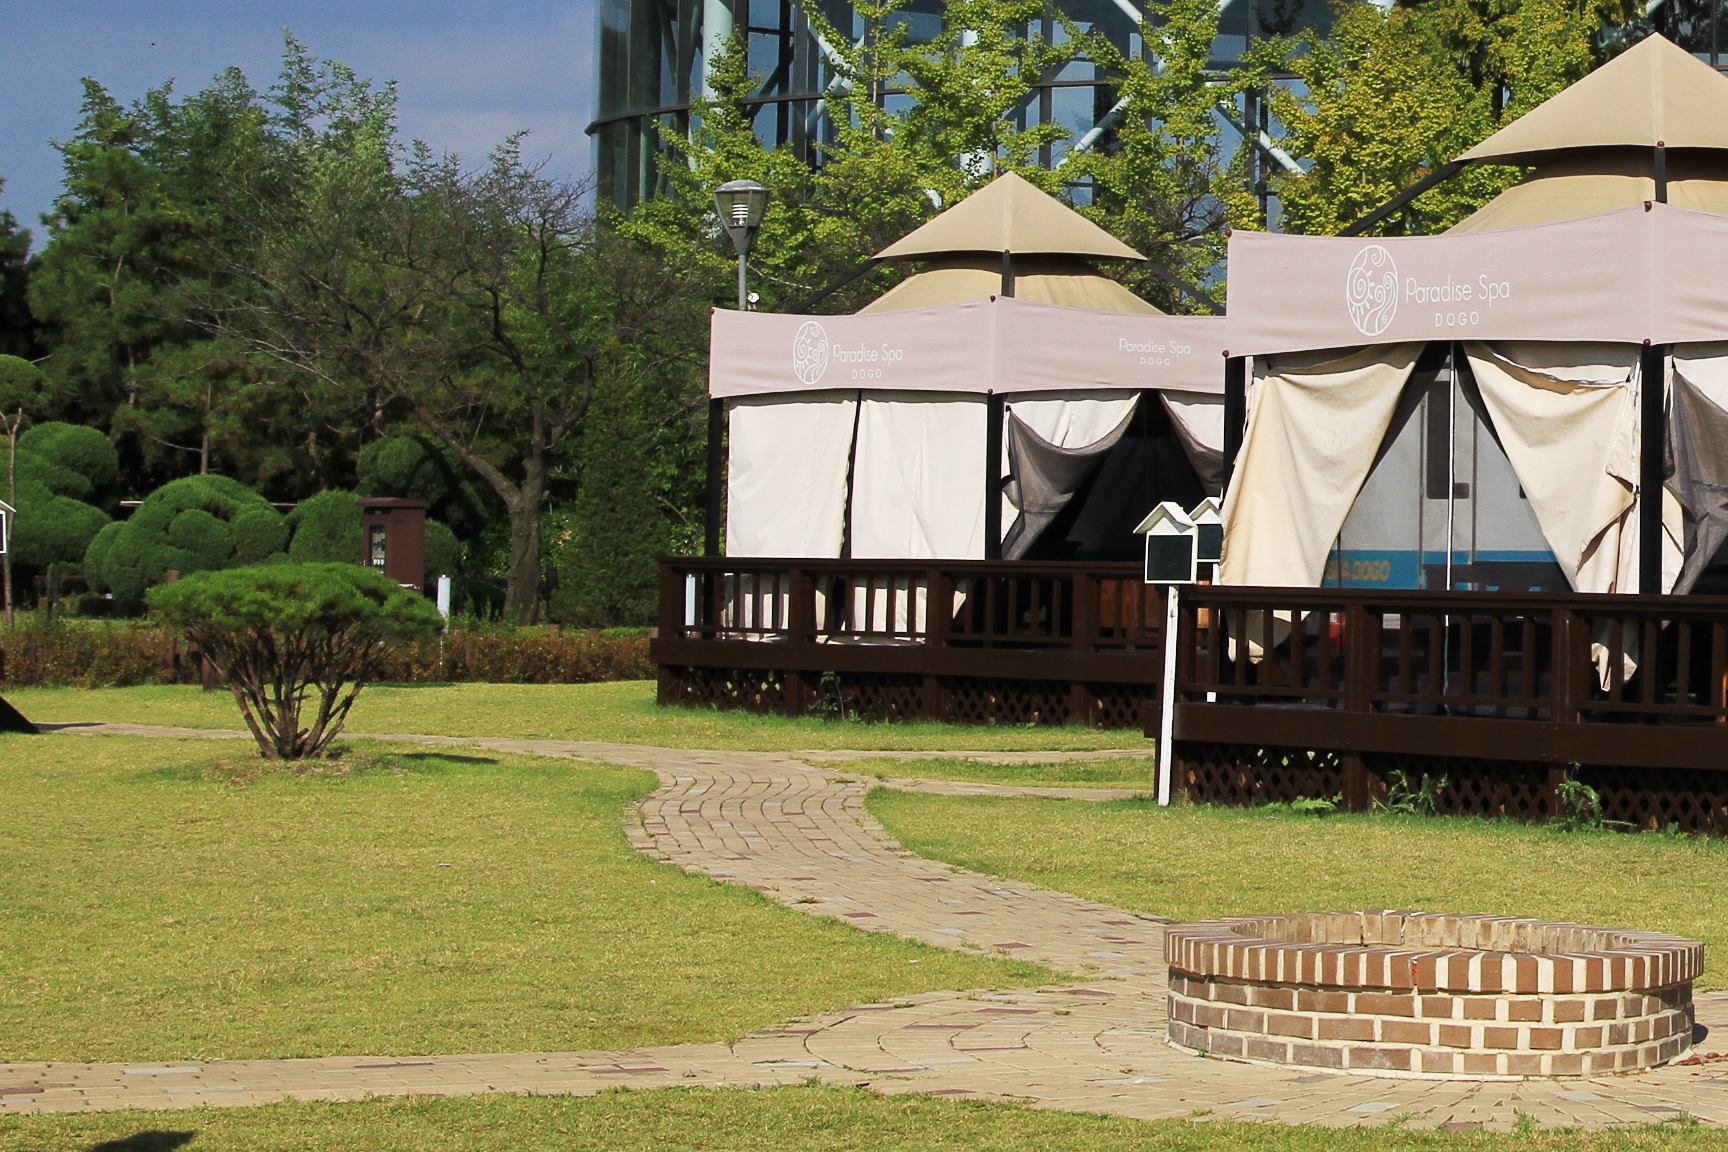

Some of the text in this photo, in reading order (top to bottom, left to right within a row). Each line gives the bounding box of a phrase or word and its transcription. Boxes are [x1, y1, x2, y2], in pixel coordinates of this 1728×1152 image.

[1405, 273, 1511, 308] Paradise Spa
[1434, 310, 1480, 328] DOGO
[832, 342, 904, 367] Paradise Spa
[1118, 337, 1192, 358] Paradise Spa
[1139, 356, 1172, 366] DOGO
[851, 368, 882, 380] DOGO
[1352, 559, 1391, 581] DOGO
